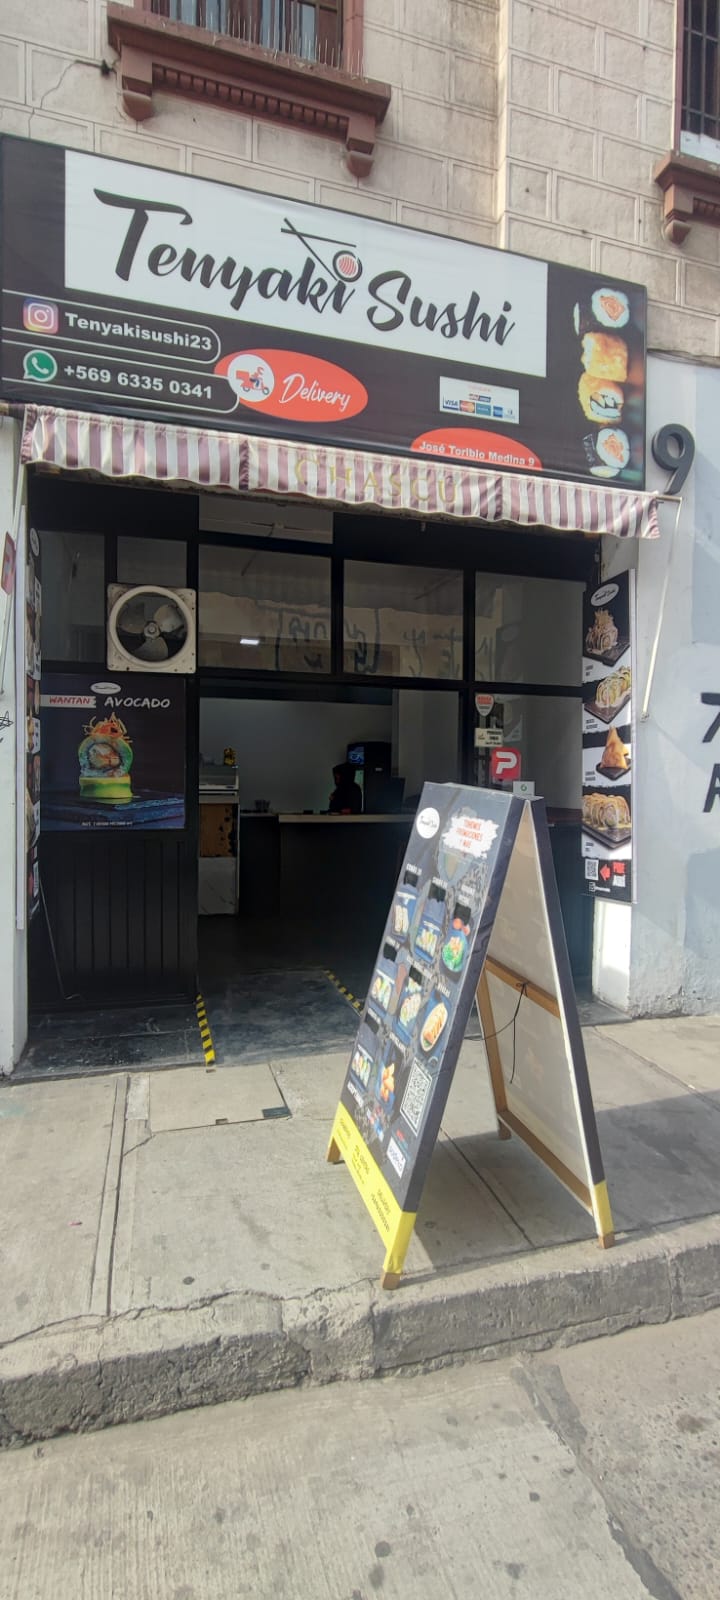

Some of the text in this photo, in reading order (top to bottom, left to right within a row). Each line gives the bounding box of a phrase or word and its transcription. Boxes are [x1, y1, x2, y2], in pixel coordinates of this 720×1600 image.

[94, 188, 516, 346] Tenyaki Sushi
[65, 312, 212, 351] Tenyakisushi23
[64, 364, 212, 400] +569 6335 0341
[278, 373, 351, 413] Delivery
[419, 441, 535, 467] José Toribio Medina 9
[652, 423, 696, 496] 9
[49, 696, 171, 709] WANTAN AVOCADO
